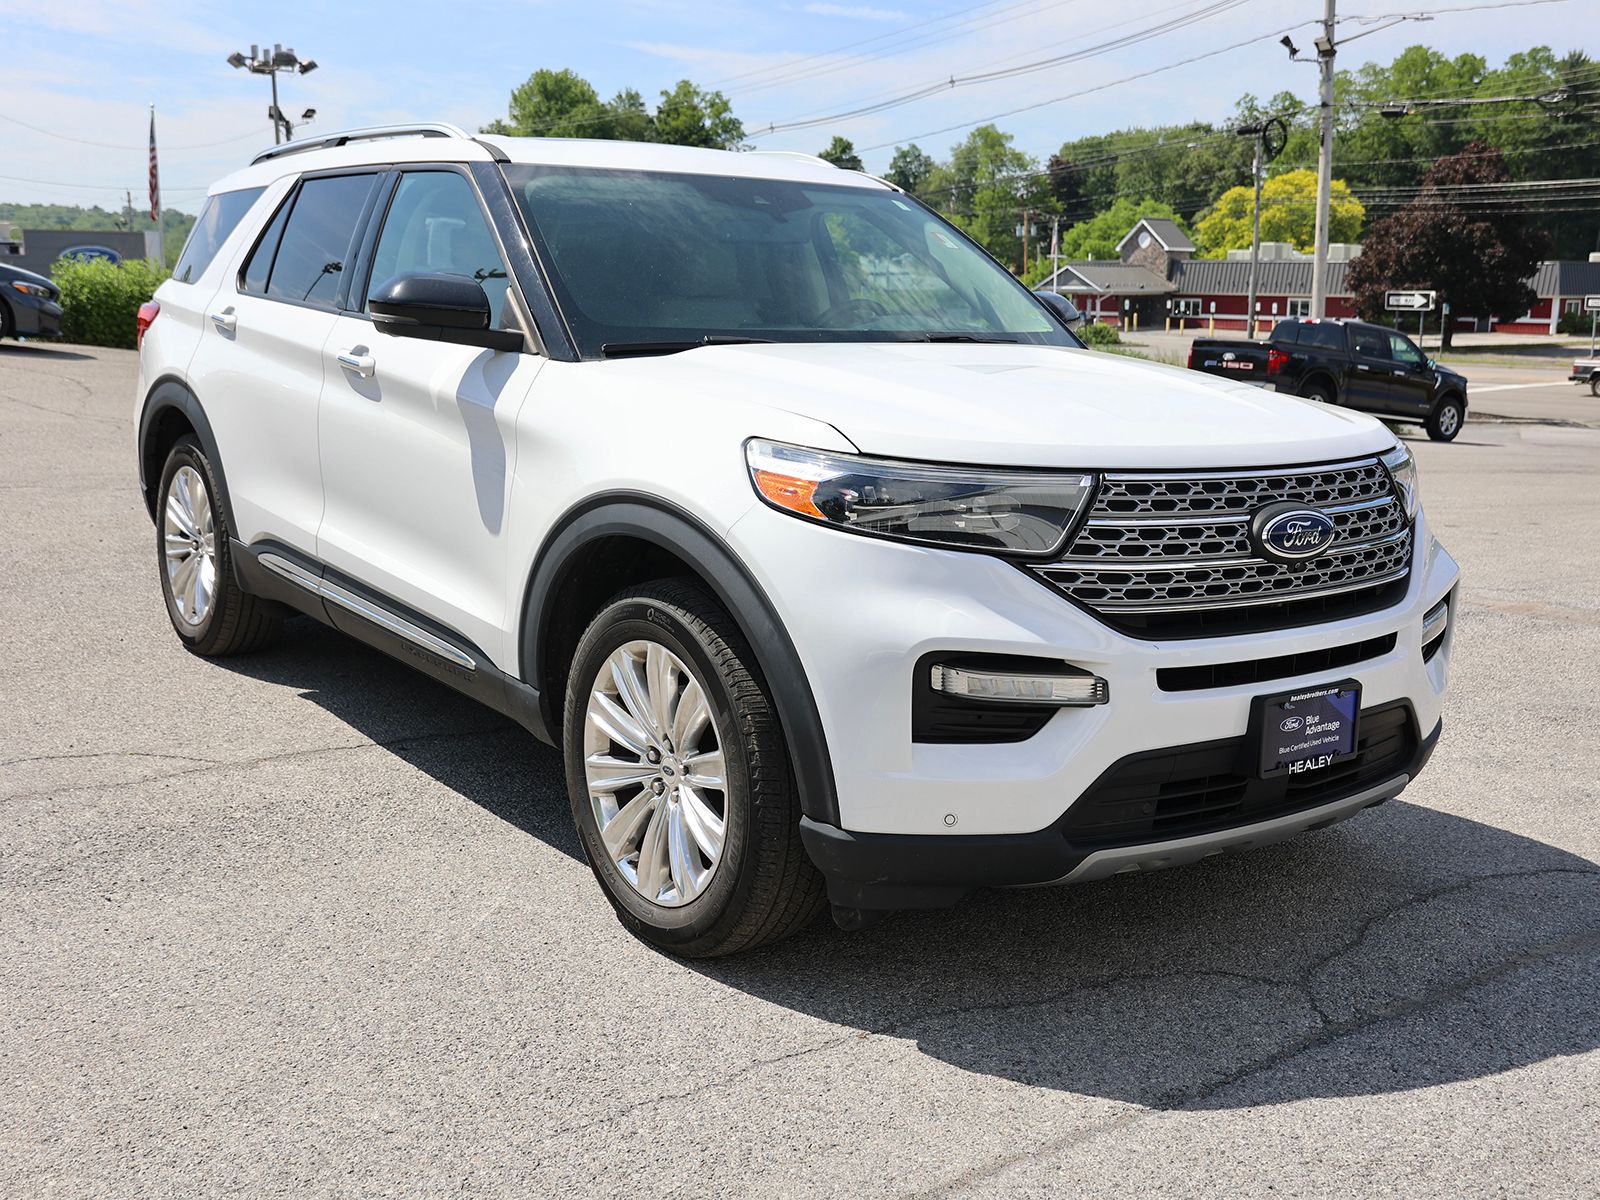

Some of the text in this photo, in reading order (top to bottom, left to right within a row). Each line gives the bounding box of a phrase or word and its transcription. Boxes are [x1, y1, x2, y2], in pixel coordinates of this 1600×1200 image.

[1284, 520, 1322, 547] Ford
[1290, 689, 1339, 701] healeybrothers.com
[1306, 715, 1320, 725] Blue
[1305, 721, 1341, 735] Advantage
[1290, 741, 1310, 751] Certified
[1310, 738, 1322, 746] Used
[1322, 735, 1340, 743] Vehicle
[1288, 754, 1333, 774] HEALEY
